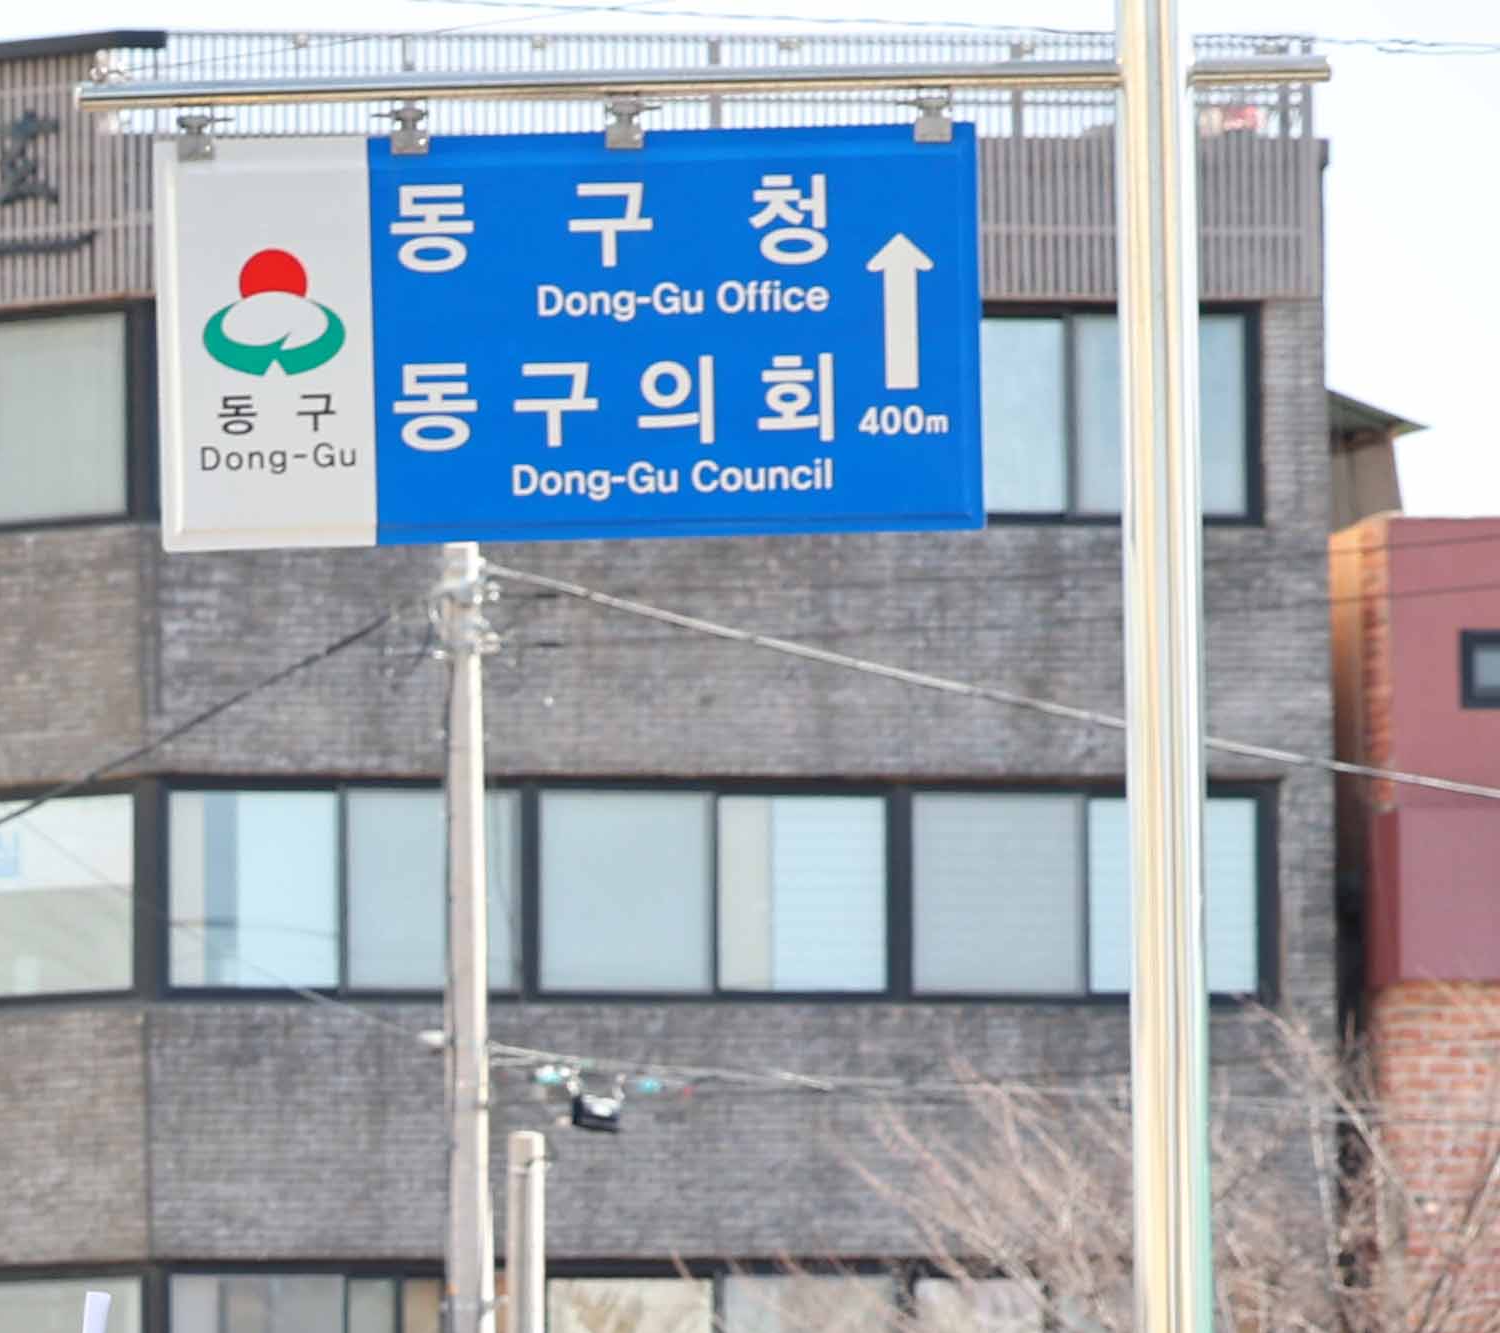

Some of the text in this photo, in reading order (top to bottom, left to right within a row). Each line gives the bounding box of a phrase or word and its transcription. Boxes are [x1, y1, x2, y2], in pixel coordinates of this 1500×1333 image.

[537, 280, 830, 322] Dong-Gu Office
[216, 392, 338, 435] 동구
[392, 351, 835, 452] 동구의회
[858, 405, 949, 437] 400m
[200, 442, 358, 474] Dong-Gu
[510, 458, 833, 501] Dong-Gu Council
